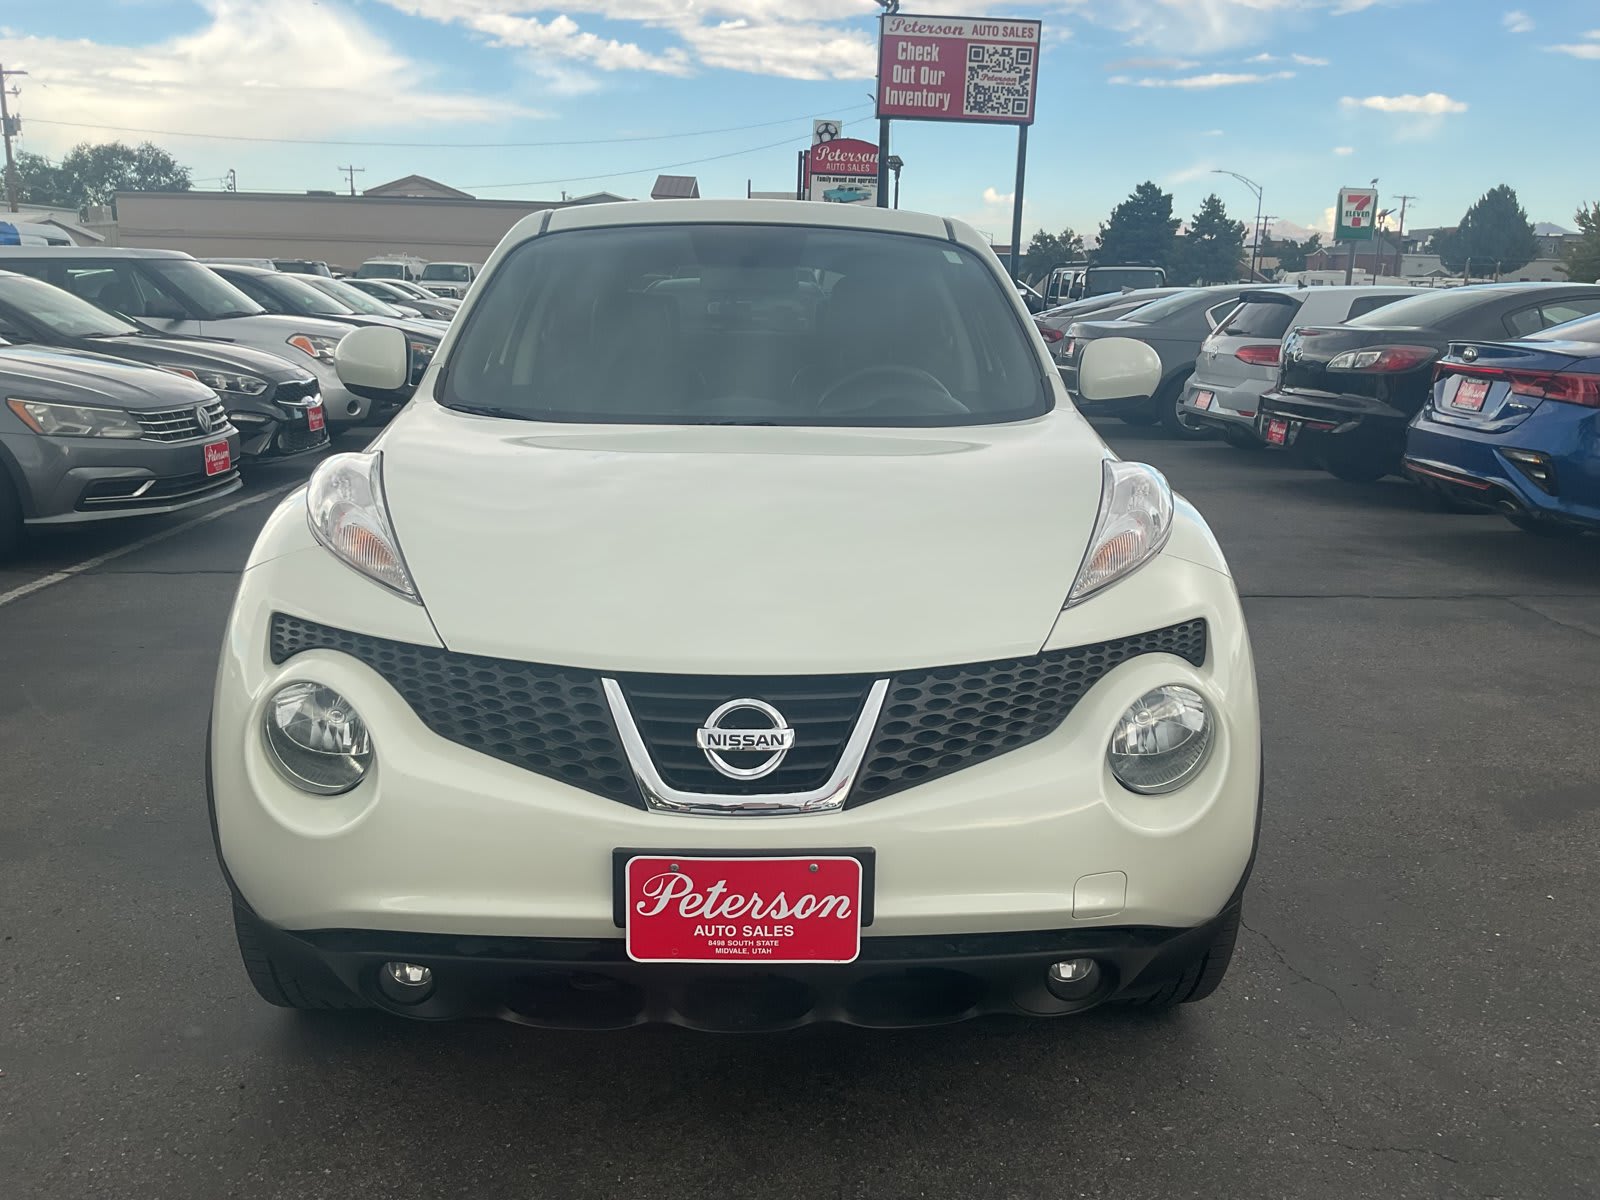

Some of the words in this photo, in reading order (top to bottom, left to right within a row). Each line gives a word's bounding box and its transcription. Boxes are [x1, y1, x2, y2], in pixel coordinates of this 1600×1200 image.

[889, 17, 965, 36] Peterson
[971, 24, 999, 37] AUTO
[1002, 26, 1034, 39] SALES
[897, 41, 939, 62] Check
[892, 65, 916, 84] Out
[920, 66, 945, 86] Our
[885, 86, 951, 111] Inventory
[816, 145, 879, 163] Peterson
[826, 163, 845, 171] AUTO
[847, 163, 870, 172] SALES
[707, 733, 785, 746] NISSAN
[636, 872, 852, 920] Peterson
[693, 925, 737, 937] AUTO
[742, 925, 794, 937] SALES
